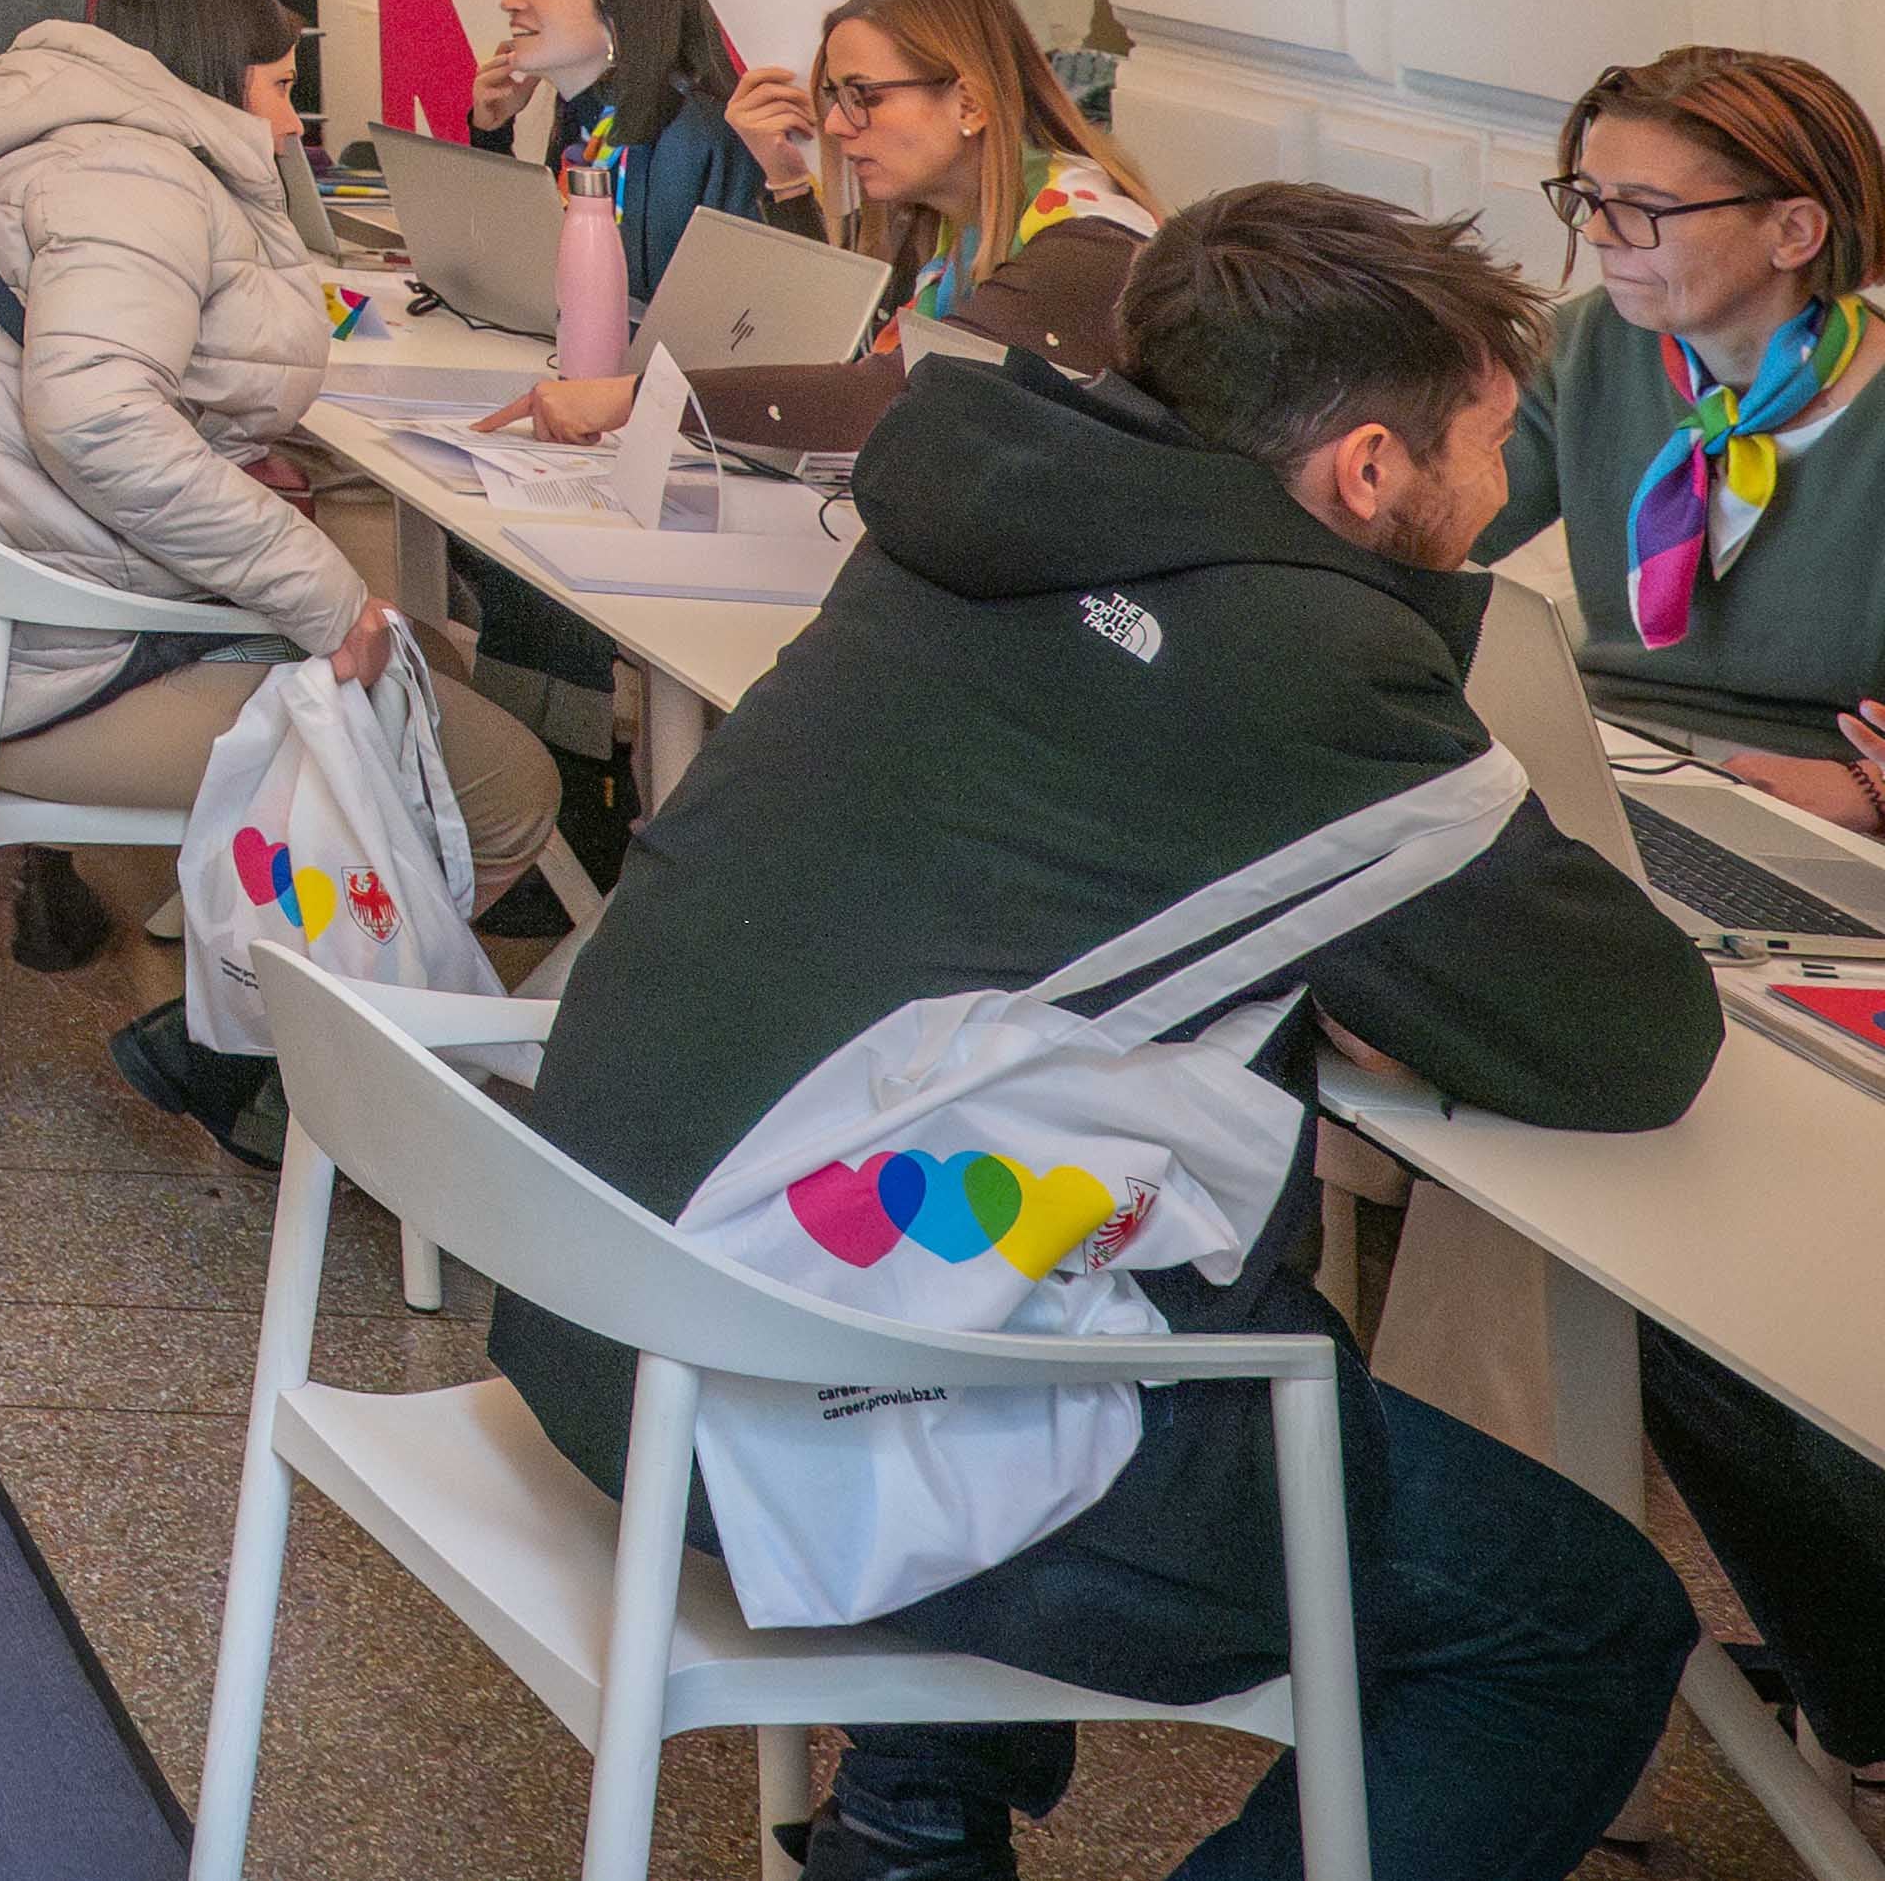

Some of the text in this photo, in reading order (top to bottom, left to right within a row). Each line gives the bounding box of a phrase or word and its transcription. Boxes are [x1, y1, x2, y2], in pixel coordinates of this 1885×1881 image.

[1079, 595, 1135, 632] NORTH
[1111, 592, 1145, 623] THE
[1083, 612, 1128, 645] FACE
